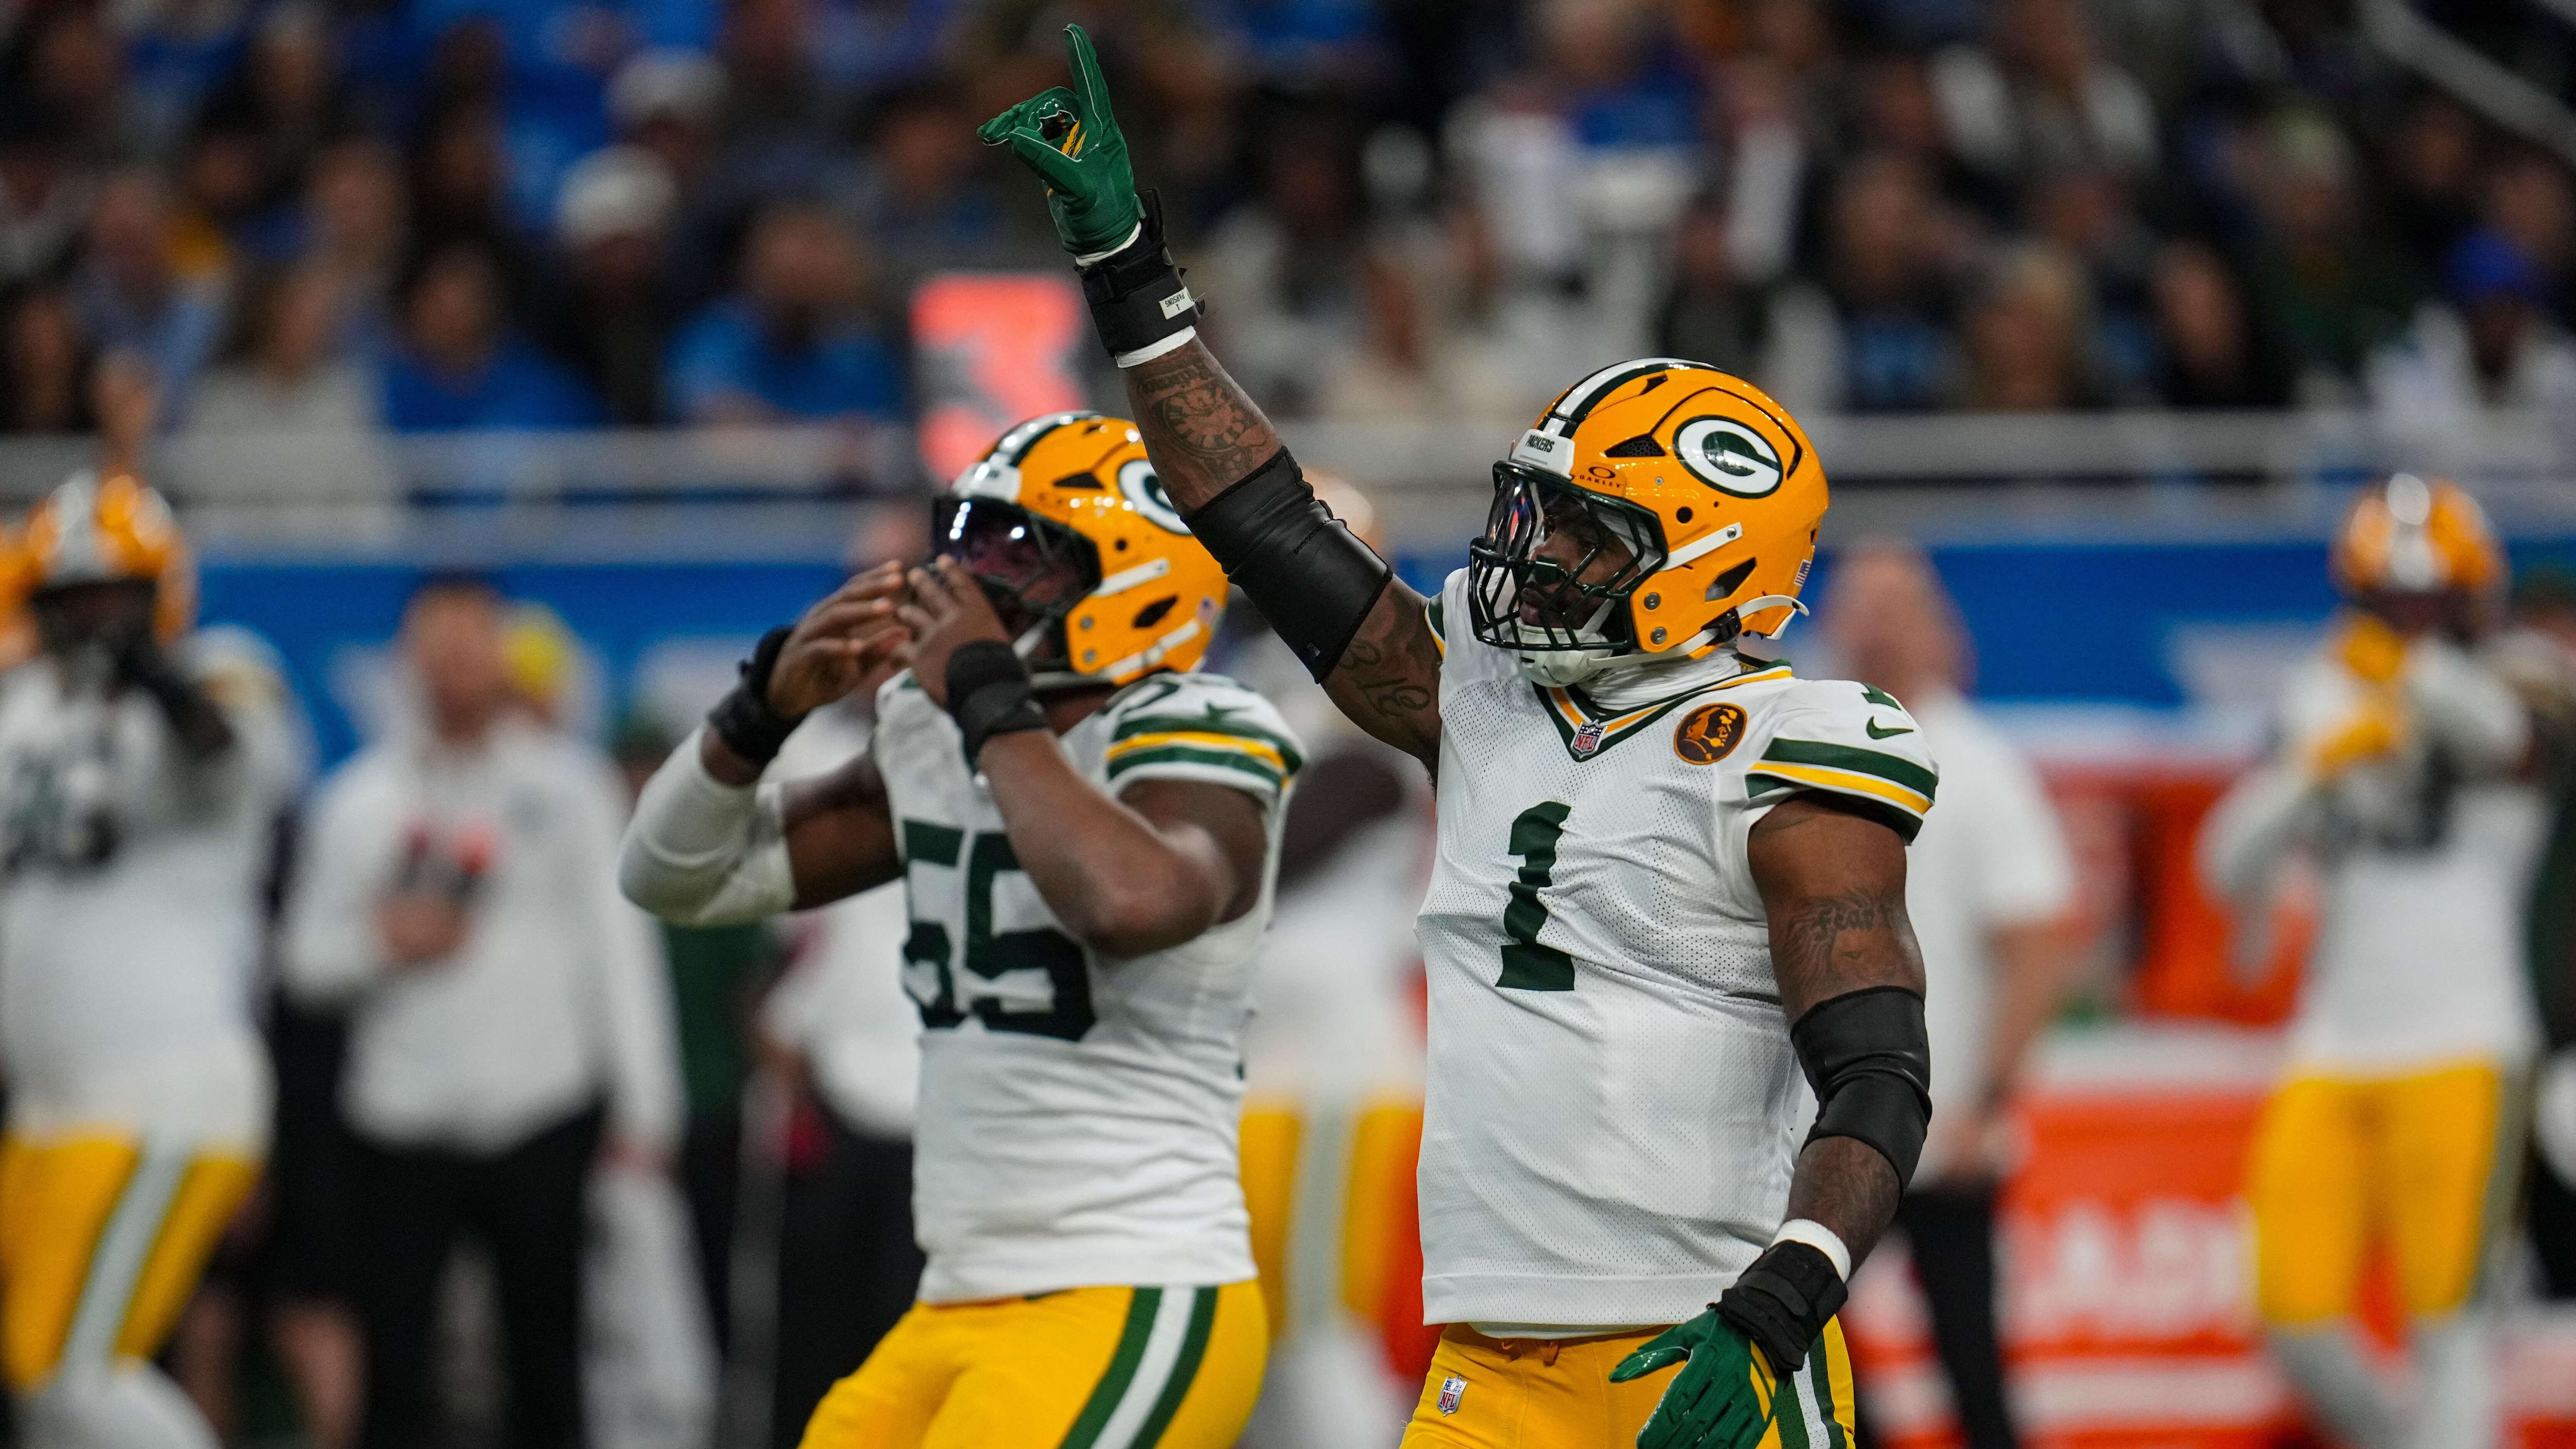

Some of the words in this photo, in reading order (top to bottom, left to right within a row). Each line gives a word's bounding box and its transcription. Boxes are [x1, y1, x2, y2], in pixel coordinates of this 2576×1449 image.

[1165, 292, 1185, 307] PARSONS
[1525, 434, 1555, 453] PACKERS
[1672, 415, 1783, 499] G
[1579, 474, 1620, 488] OAKLEY
[1575, 735, 1595, 751] NFL
[1495, 800, 1575, 991] 1
[902, 820, 1096, 1043] 55
[1440, 1391, 1455, 1409] NFL
